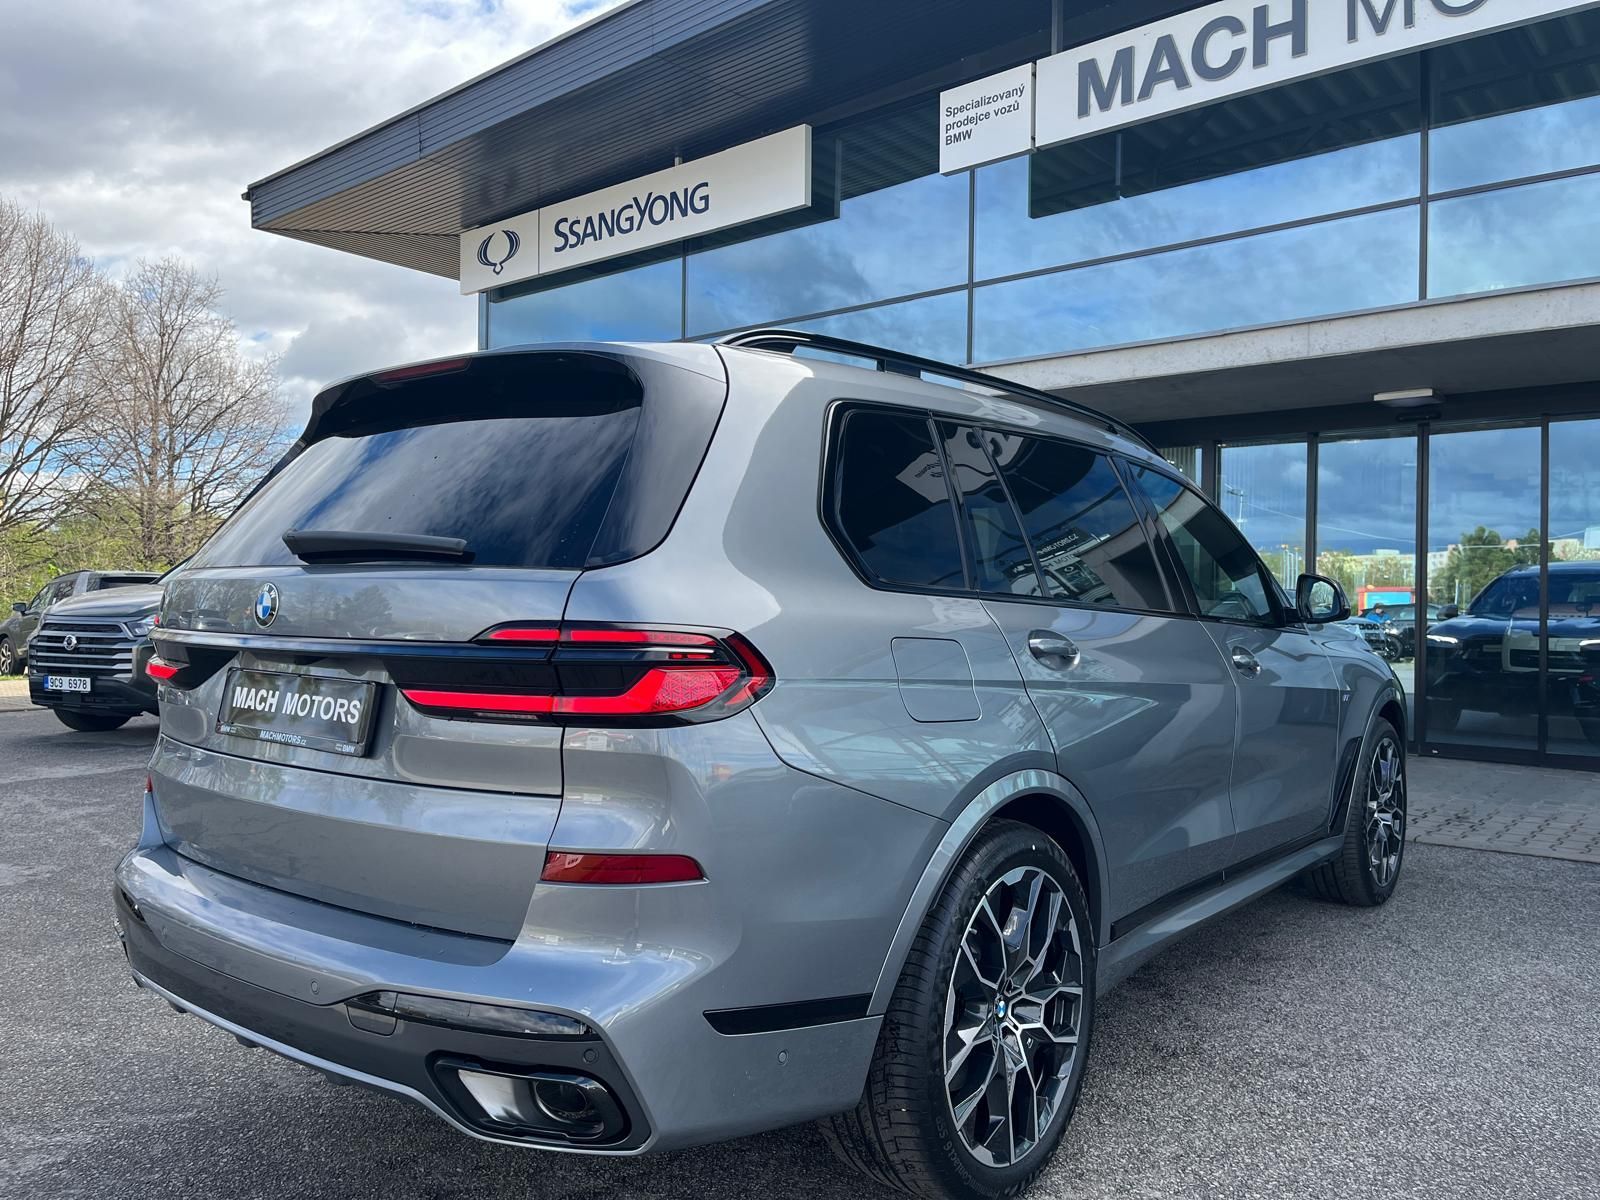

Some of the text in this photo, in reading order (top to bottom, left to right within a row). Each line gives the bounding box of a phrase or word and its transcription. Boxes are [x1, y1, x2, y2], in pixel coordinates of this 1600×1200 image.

[1077, 2, 1308, 118] MACH
[945, 83, 1025, 118] Specializovaný
[945, 100, 1019, 134] prodejce vozů
[945, 129, 972, 146] BMW
[49, 677, 87, 689] 9C9 6978
[232, 686, 361, 724] MACH MOTORS
